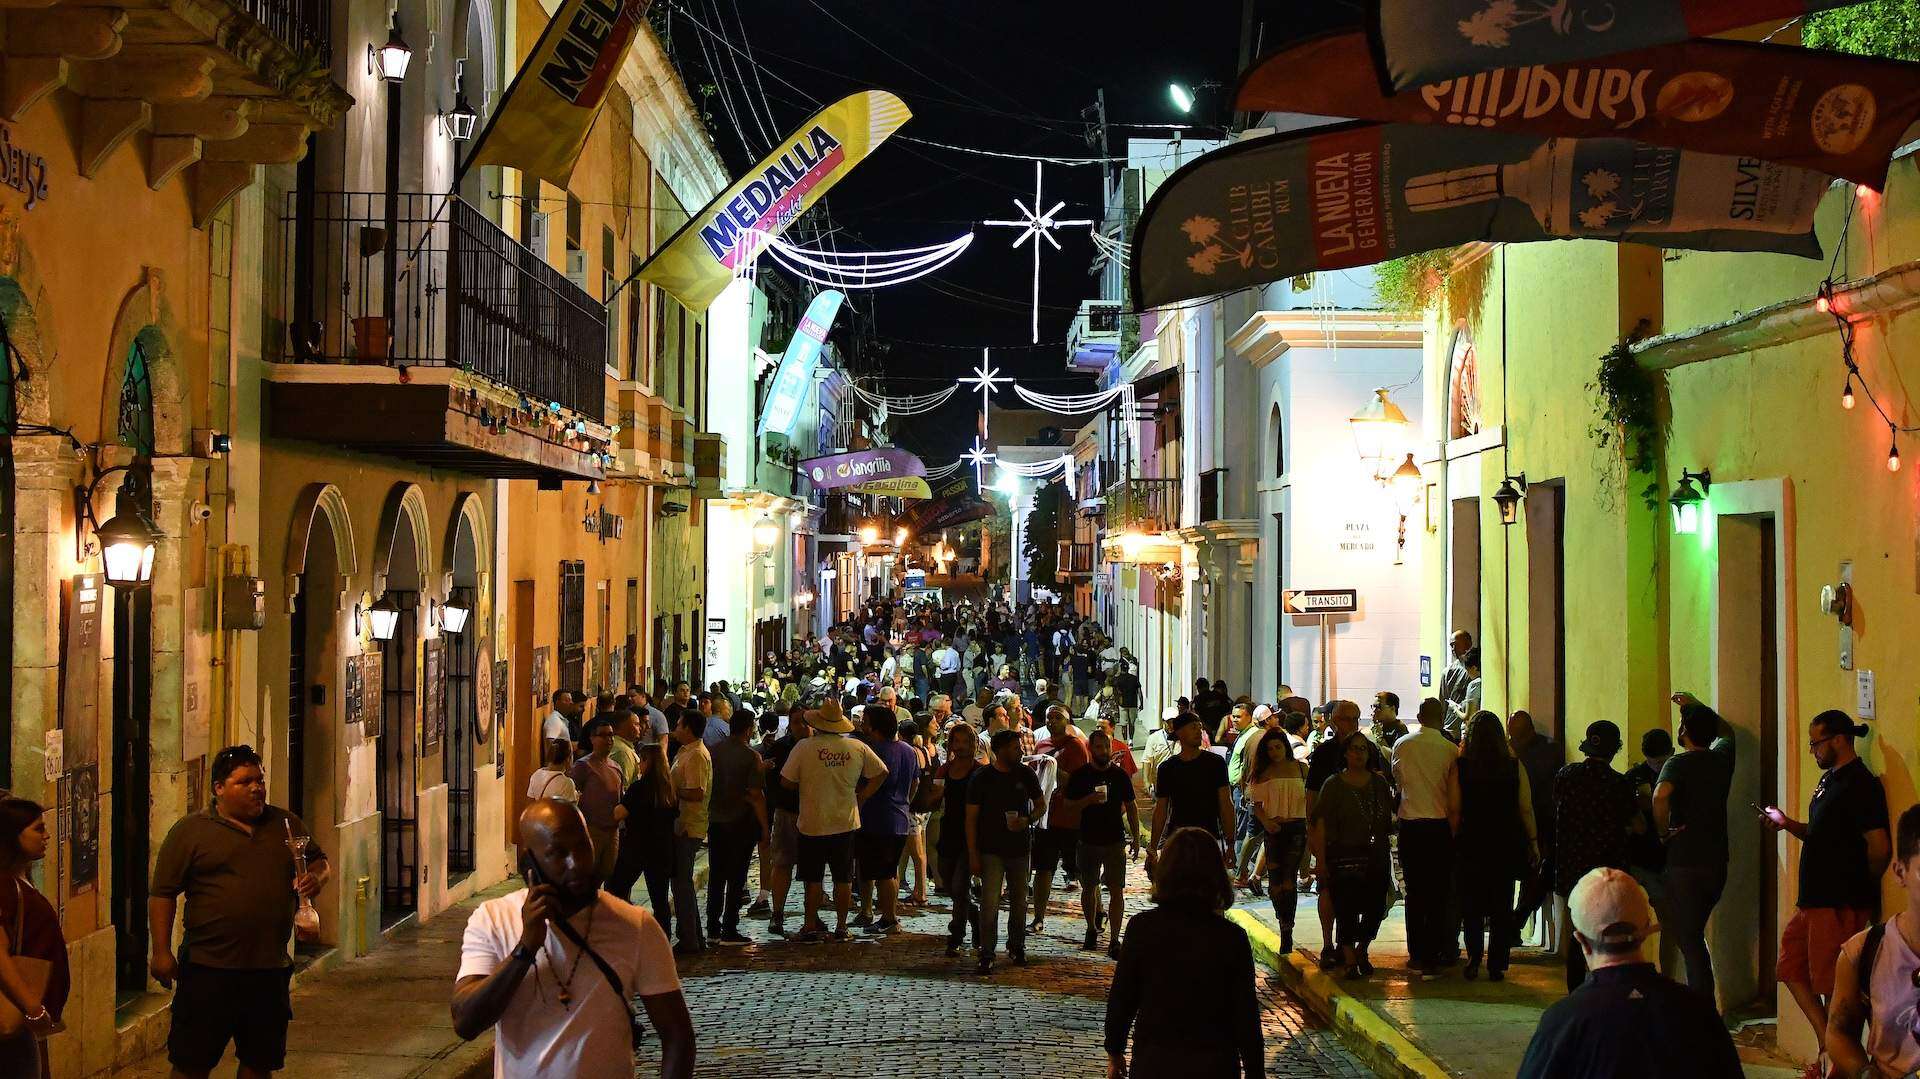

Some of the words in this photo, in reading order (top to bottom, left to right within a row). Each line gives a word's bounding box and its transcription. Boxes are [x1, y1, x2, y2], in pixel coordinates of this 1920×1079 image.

[698, 124, 842, 263] MEDALLA
[1275, 179, 1291, 215] RUM
[1315, 151, 1352, 223] NUEVA
[1730, 157, 1762, 221] SILVE
[1230, 184, 1250, 241] CLUB
[1251, 182, 1279, 270] CARIBE
[1320, 222, 1356, 257] LA
[1345, 523, 1370, 532] PLAZA
[1340, 543, 1375, 551] MERCADO
[1306, 596, 1350, 607] TRANSITO
[817, 749, 851, 761] Coors
[824, 760, 846, 768] LIGHT
